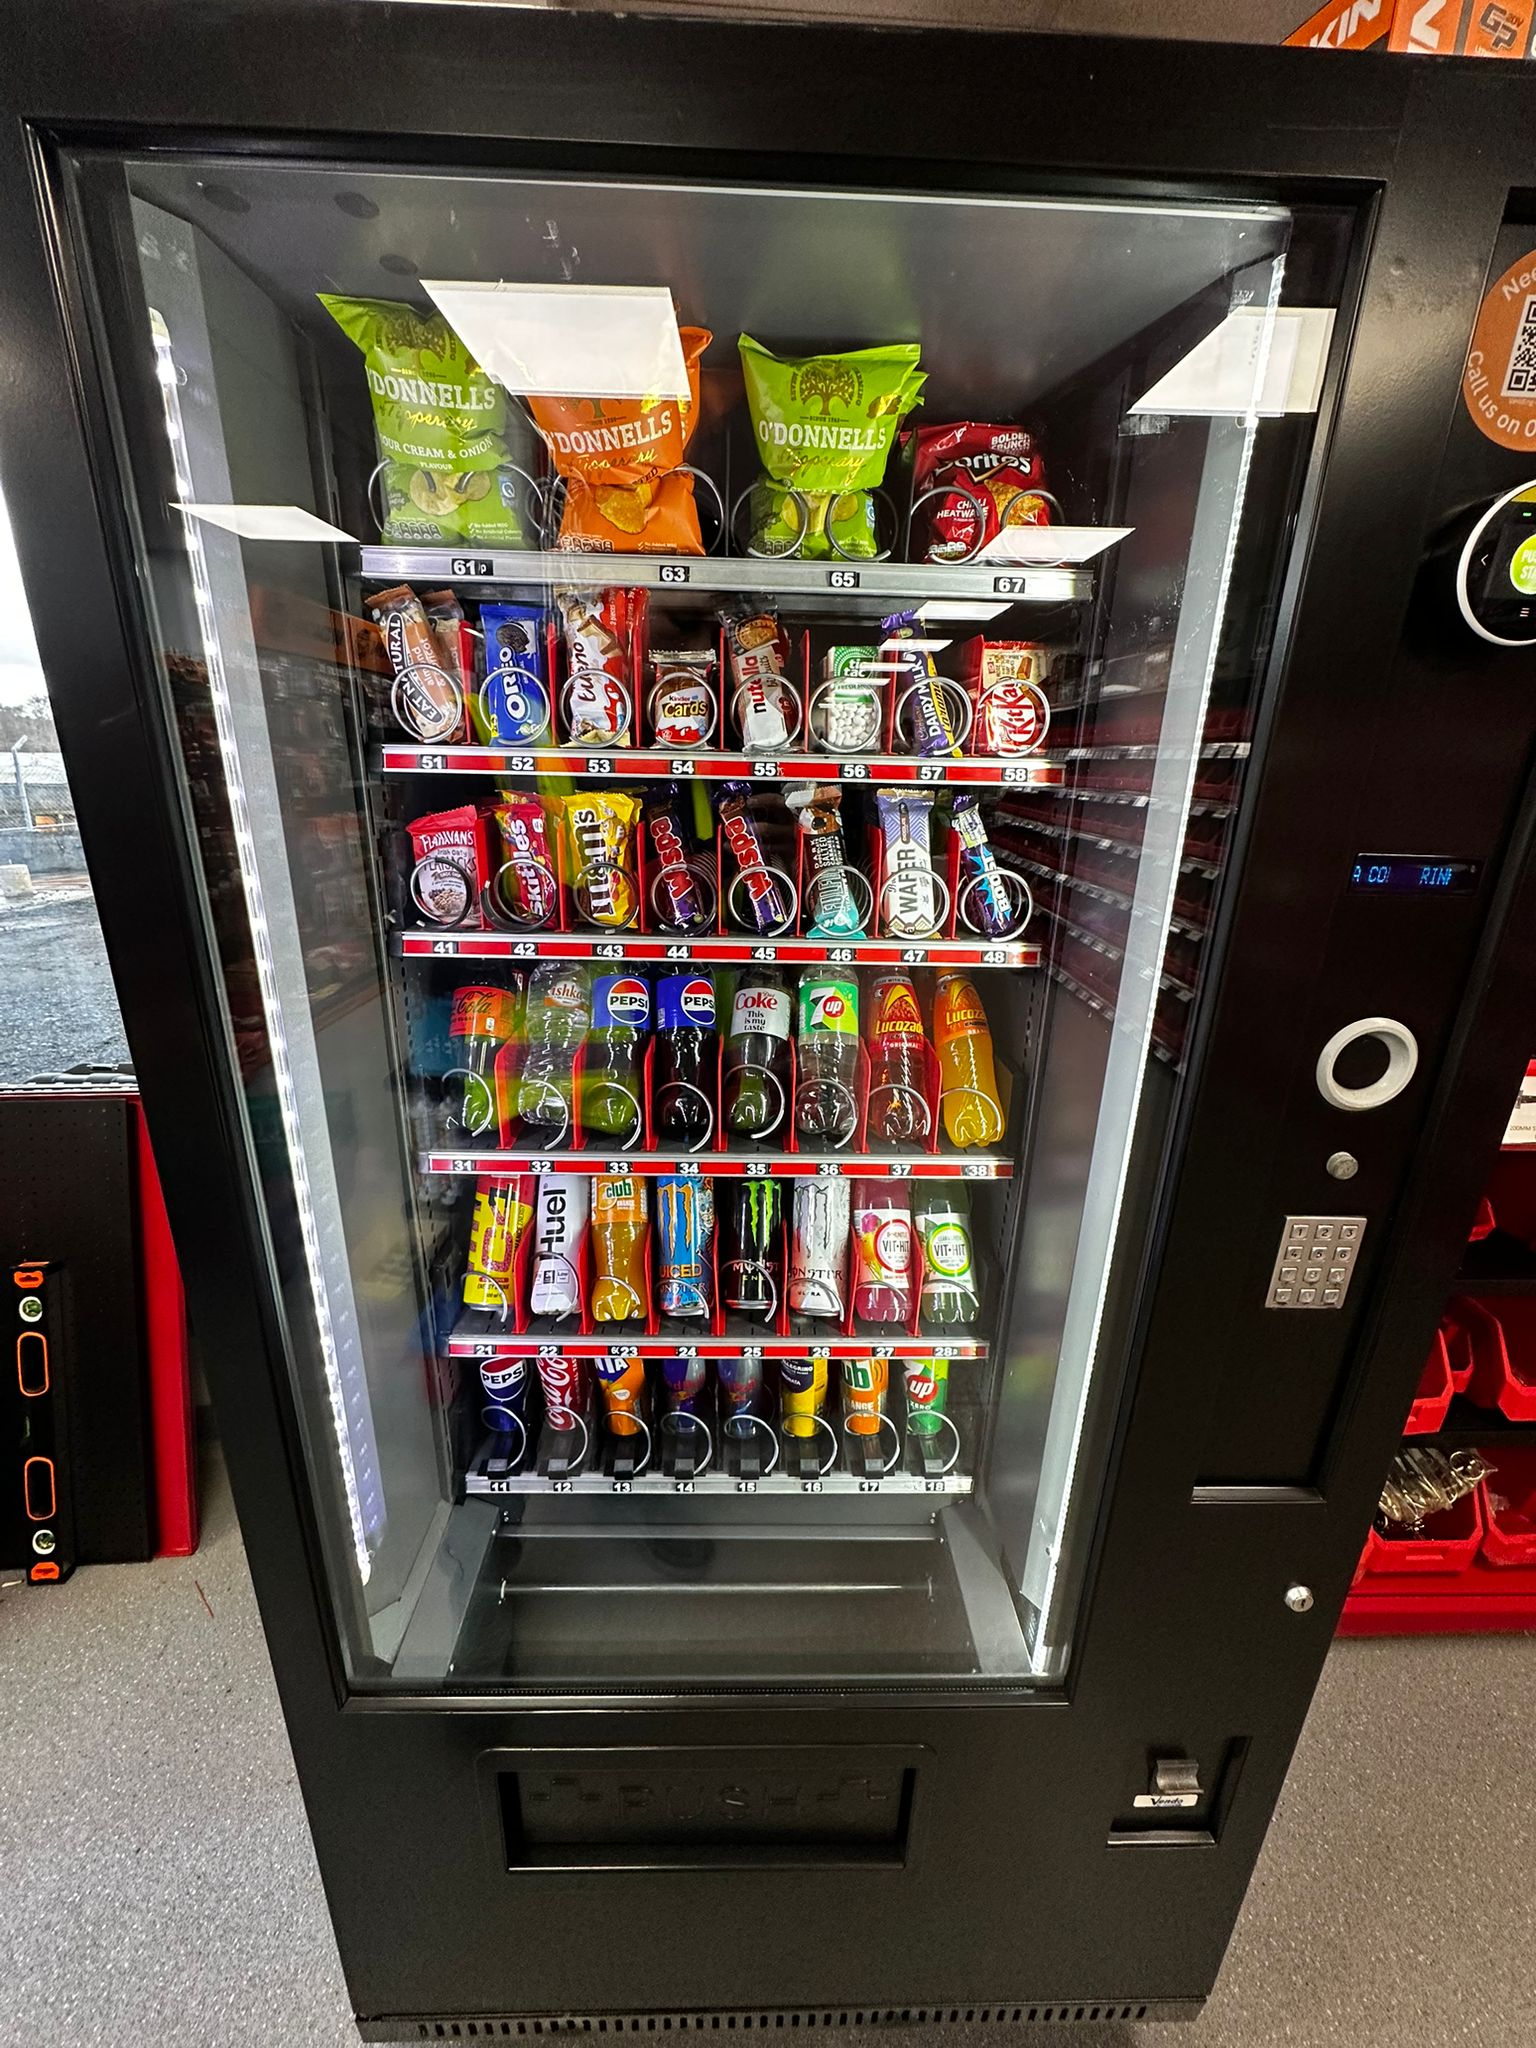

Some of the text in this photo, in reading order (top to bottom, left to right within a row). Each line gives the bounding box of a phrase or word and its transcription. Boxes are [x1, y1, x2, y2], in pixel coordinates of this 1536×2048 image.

[1502, 267, 1536, 300] Nee
[1467, 351, 1489, 396] Call
[1479, 396, 1498, 419] us
[1497, 414, 1520, 435] on
[759, 421, 887, 449] O'DONNELLS
[380, 433, 493, 459] OUR CREAM & ONION
[420, 461, 454, 470] FLAVOUR
[937, 506, 989, 519] HEATWAE
[662, 567, 685, 581] 63
[831, 572, 855, 587] 65
[999, 578, 1025, 592] 67
[844, 668, 866, 678] tac
[499, 646, 526, 719] OREO
[412, 696, 437, 720] EAT
[664, 700, 708, 718] Cards
[920, 698, 941, 737] DAIRY
[422, 756, 443, 769] 51
[512, 757, 534, 770] 52
[588, 759, 611, 773] 53
[672, 761, 695, 774] 54
[754, 763, 777, 776] 55
[843, 764, 866, 778] 56
[921, 767, 943, 780] 57
[1004, 769, 1027, 782] 58
[419, 830, 474, 853] FLAHAVAN'S
[651, 816, 694, 900] Wspa
[820, 836, 831, 867] SALTED
[434, 941, 455, 954] 41
[514, 943, 536, 956] 42
[603, 945, 624, 957] 43
[667, 946, 689, 959] 44
[754, 947, 776, 960] 45
[830, 949, 852, 961] 46
[904, 950, 925, 963] 47
[983, 951, 1005, 964] 48
[610, 997, 648, 1009] PEPSI
[684, 997, 714, 1010] PEPS
[735, 993, 778, 1010] Coke
[744, 1024, 765, 1032] taste
[454, 1160, 472, 1171] 31
[531, 1161, 551, 1172] 32
[609, 1163, 629, 1173] 33
[679, 1163, 699, 1174] 34
[747, 1164, 766, 1175] 35
[819, 1165, 839, 1175] 36
[892, 1165, 911, 1176] 37
[968, 1166, 988, 1176] 38
[606, 1179, 633, 1198] club
[539, 1188, 567, 1261] Huel
[476, 1346, 492, 1355] 21
[539, 1346, 558, 1356] 22
[679, 1347, 697, 1357] 24
[743, 1348, 762, 1357] 25
[812, 1348, 831, 1357] 26
[876, 1348, 894, 1357] 27
[491, 1482, 507, 1492] 11
[554, 1483, 572, 1492] 12
[614, 1483, 631, 1492] 13
[677, 1483, 694, 1492] 14
[738, 1483, 756, 1492] 15
[805, 1483, 823, 1492] 16
[860, 1483, 878, 1492] 17
[927, 1482, 945, 1492] 18
